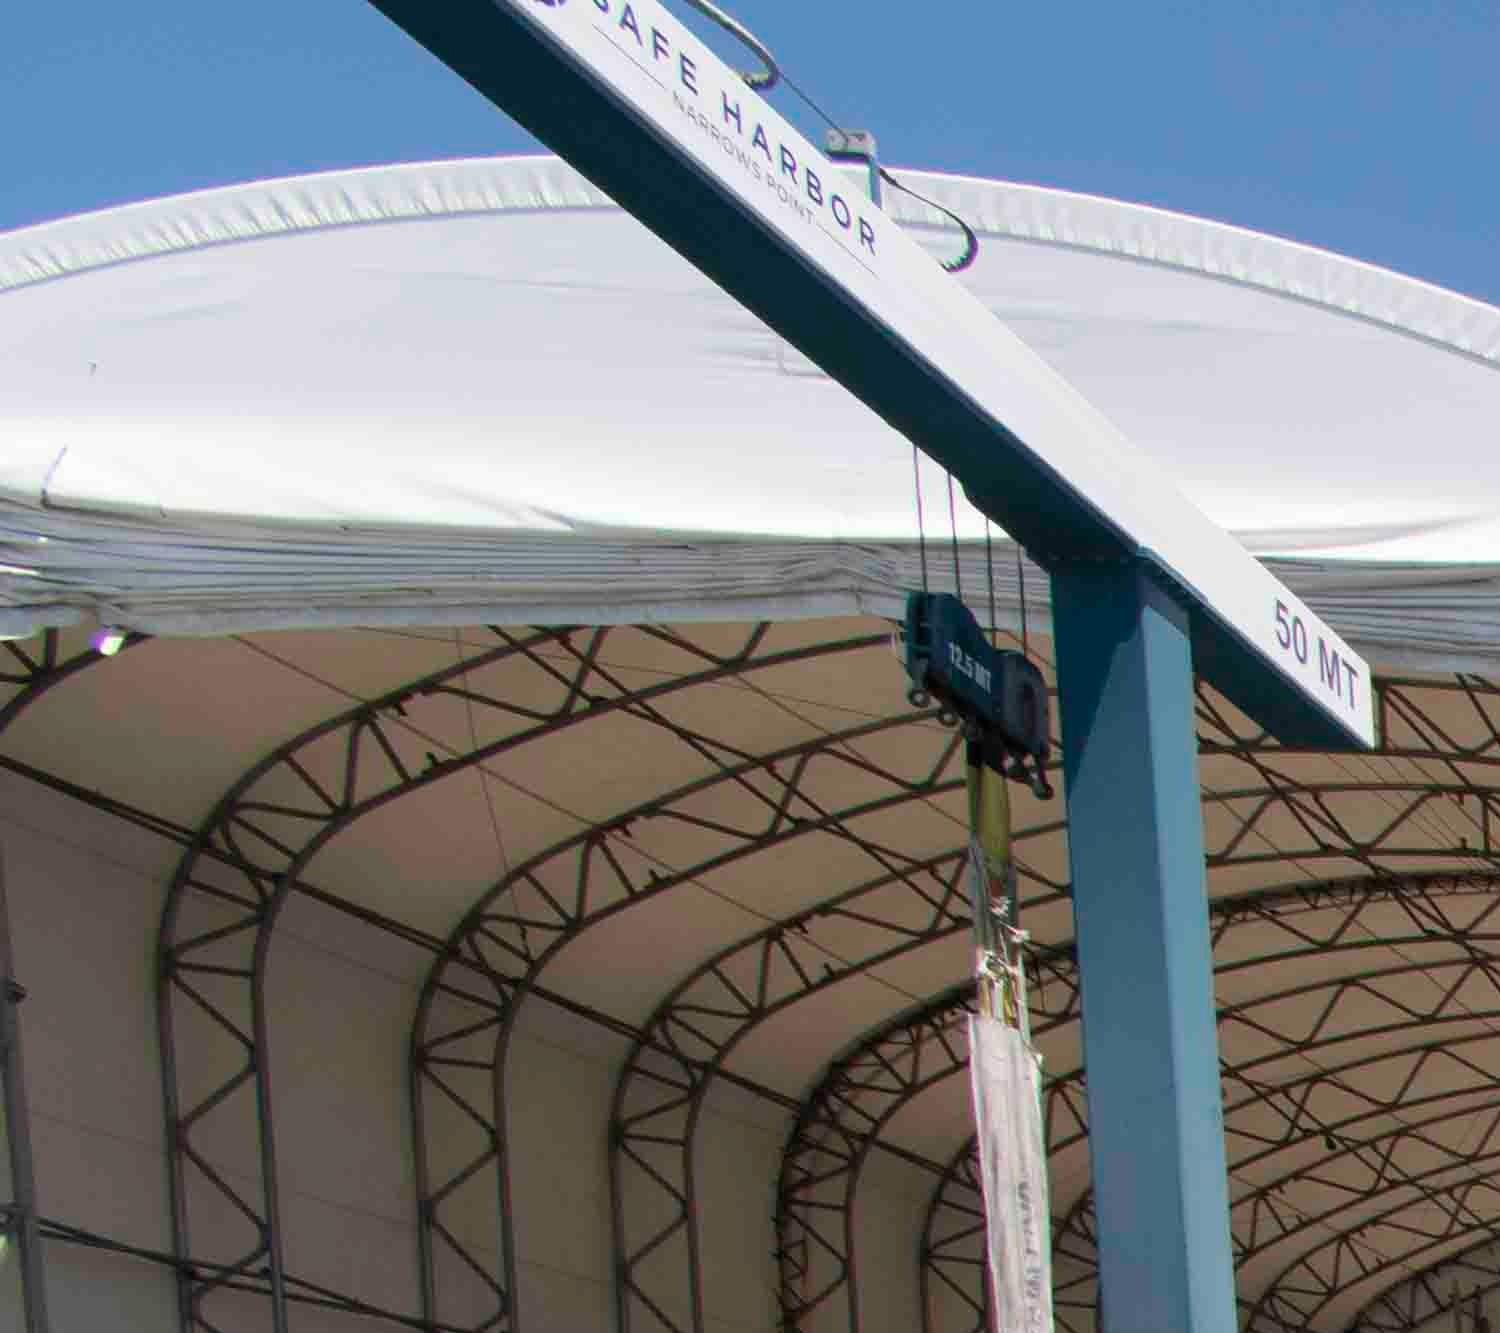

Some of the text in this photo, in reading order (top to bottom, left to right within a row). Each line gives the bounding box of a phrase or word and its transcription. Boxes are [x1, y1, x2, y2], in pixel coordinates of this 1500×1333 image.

[673, 90, 815, 225] NARROWS POINT
[722, 90, 876, 256] HARBOR
[948, 641, 974, 679] 12.5
[1274, 600, 1358, 709] 50 MT
